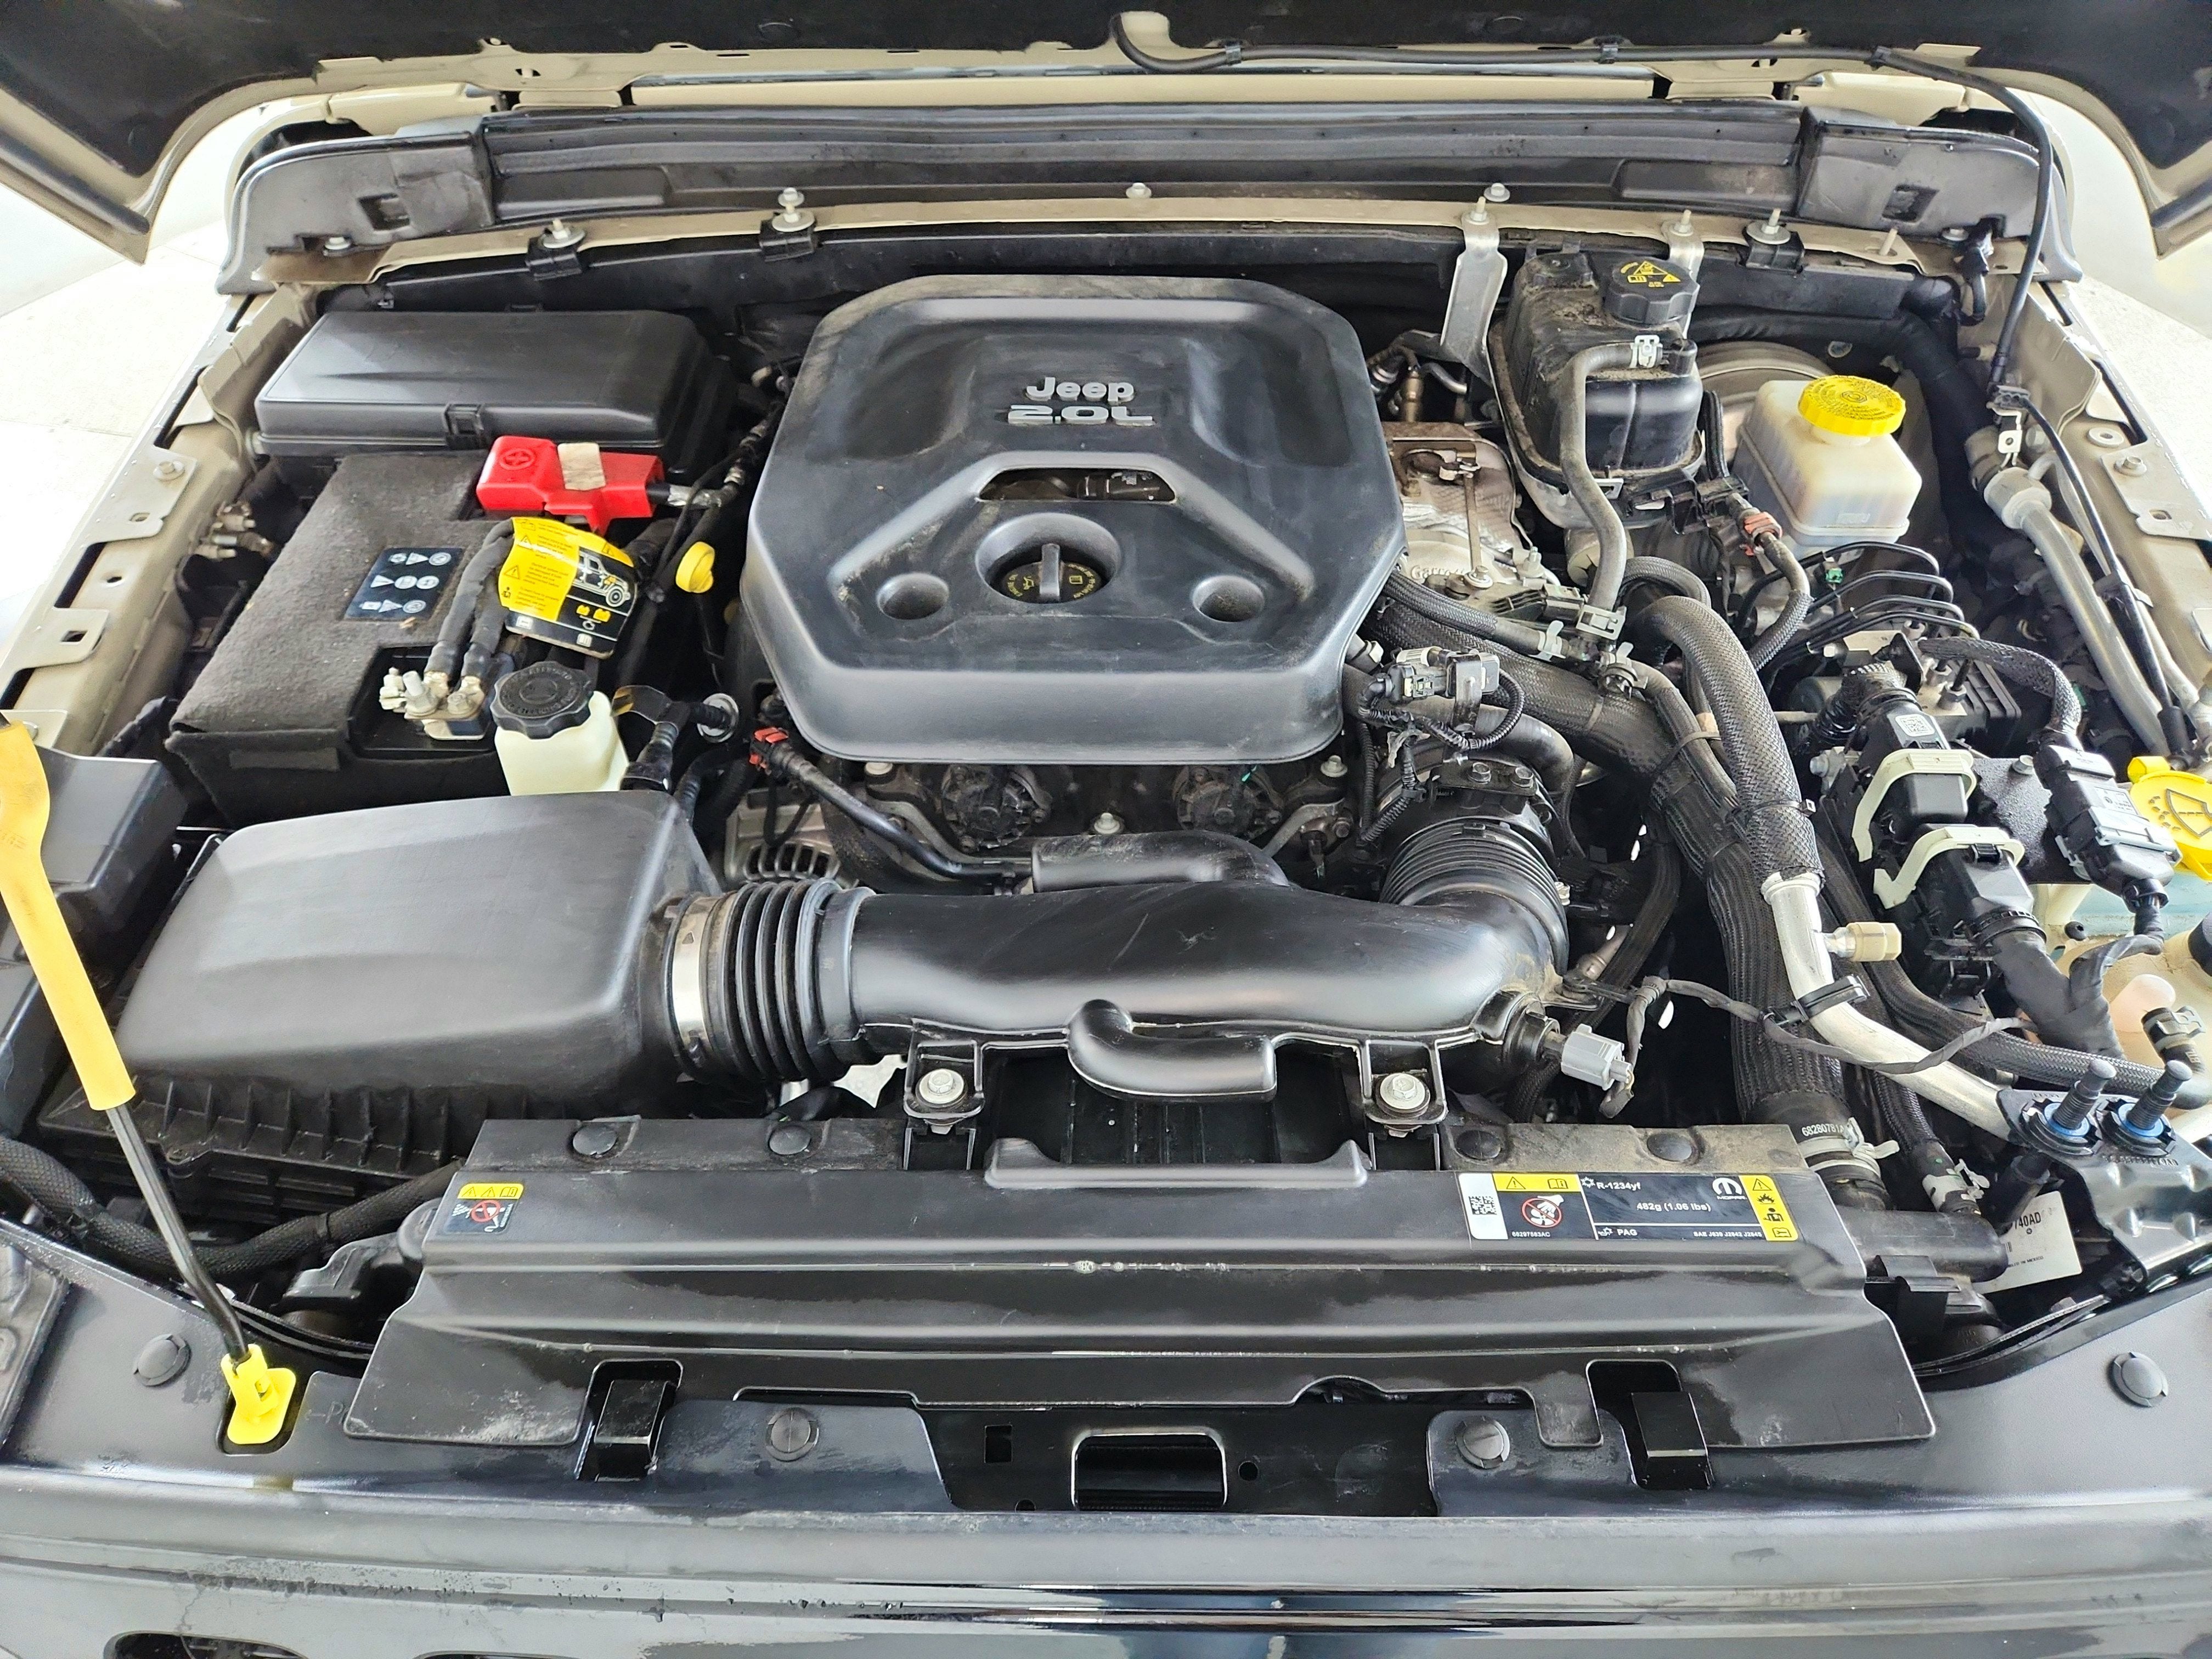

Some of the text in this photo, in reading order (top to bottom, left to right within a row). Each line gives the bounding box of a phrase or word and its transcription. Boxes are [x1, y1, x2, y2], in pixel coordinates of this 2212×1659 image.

[1025, 377, 1135, 404] Jeep
[1008, 405, 1155, 426] 2.0L
[1596, 1182, 1641, 1191] R-1234yf
[1637, 1203, 1711, 1212] 482g (1.06 lbs)
